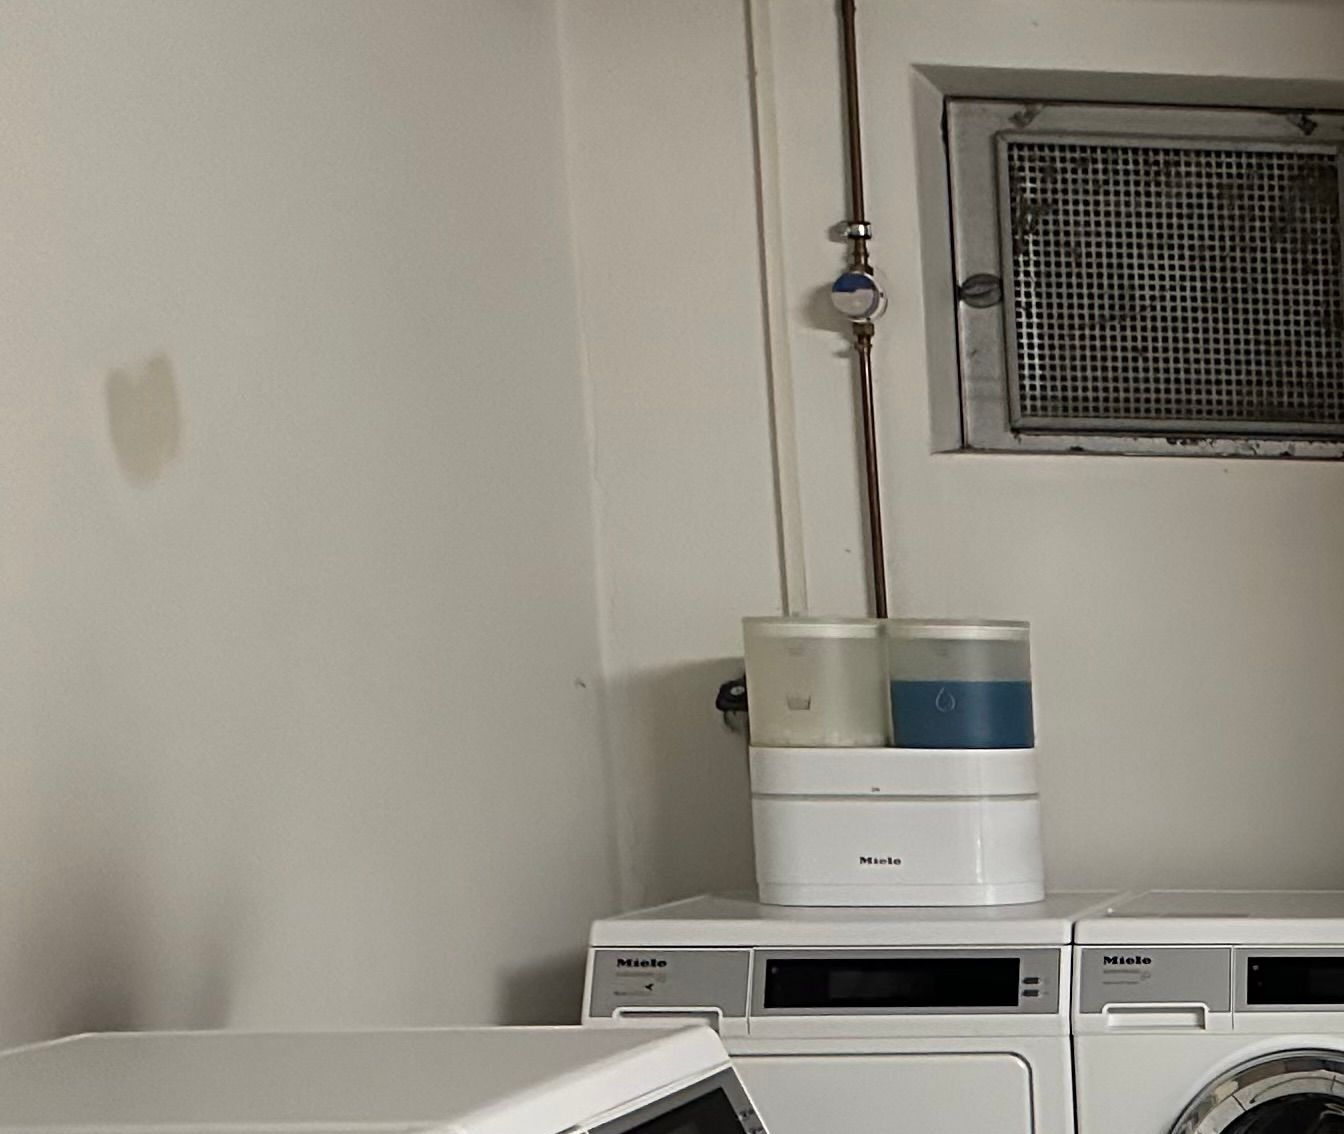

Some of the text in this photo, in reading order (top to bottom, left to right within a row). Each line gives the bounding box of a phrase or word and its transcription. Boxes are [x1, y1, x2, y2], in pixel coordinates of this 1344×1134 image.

[859, 856, 902, 866] Miele
[616, 958, 668, 968] Miele
[1103, 956, 1152, 965] Miele
